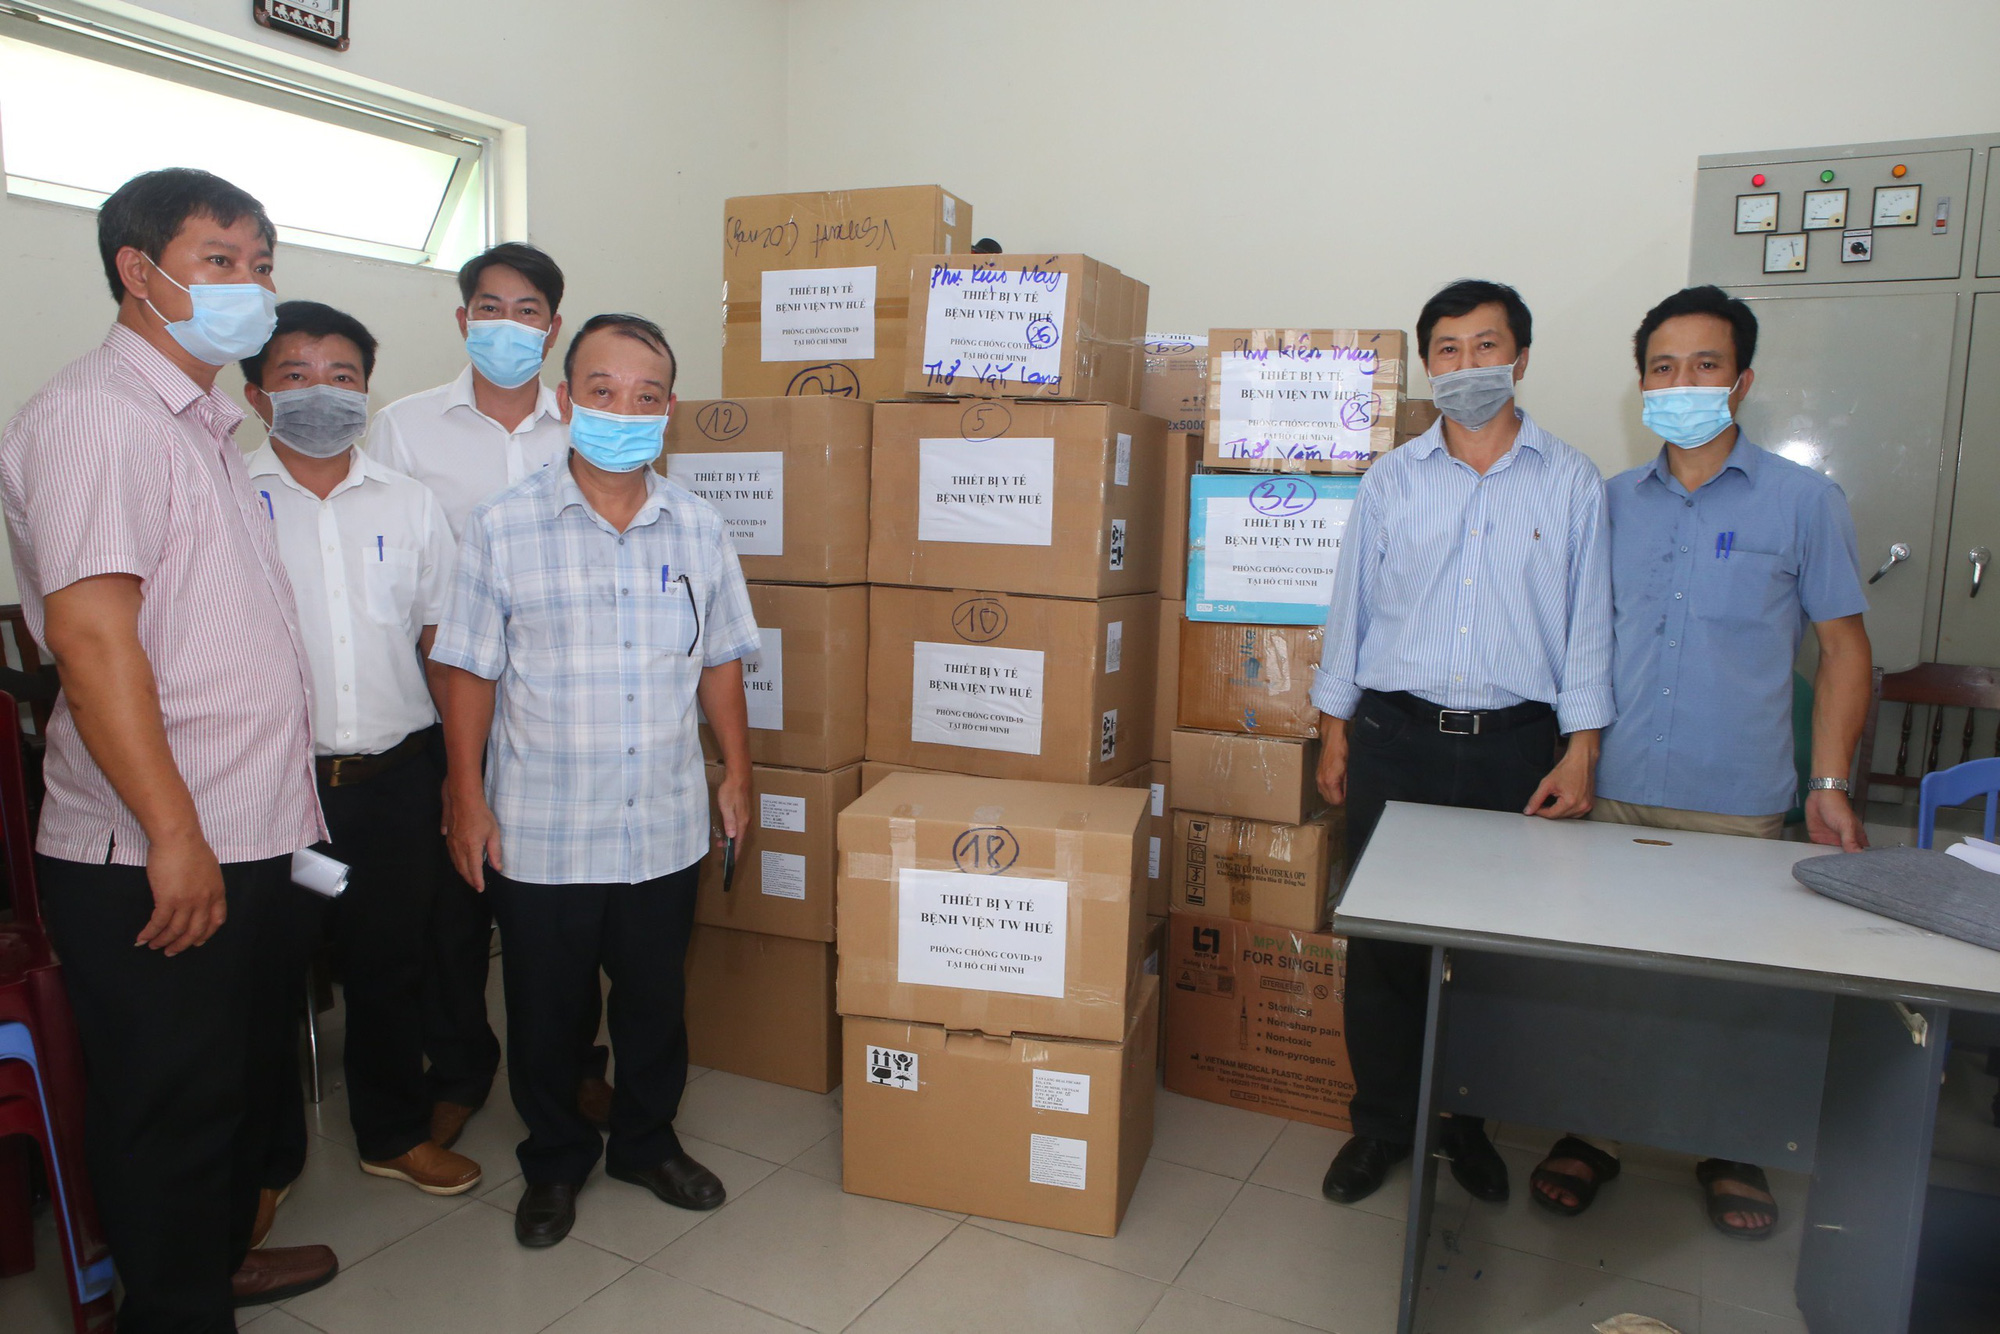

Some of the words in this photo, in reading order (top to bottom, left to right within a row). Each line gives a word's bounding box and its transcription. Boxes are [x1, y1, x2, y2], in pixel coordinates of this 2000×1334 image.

[789, 285, 818, 295] THIẾT
[821, 287, 830, 296] BỊ
[833, 286, 839, 294] Y
[962, 289, 996, 301] THIẾT
[999, 292, 1010, 303] BỊ
[1014, 293, 1022, 302] Y
[1024, 291, 1039, 303] TẾ
[776, 303, 801, 313] BỆNH
[804, 301, 825, 312] VIỆN
[846, 299, 865, 309] HUẾ
[945, 308, 975, 319] BỆNH
[978, 309, 1004, 322] VIỆN
[1008, 311, 1024, 321] TW
[1029, 311, 1052, 323] HUẾ
[782, 327, 804, 335] PHÒNG
[1031, 326, 1050, 343] 26
[817, 337, 828, 345] CHÍ
[951, 337, 976, 347] PHÒNG
[978, 339, 1005, 348] CHỐNG
[963, 352, 976, 360] TẠI
[977, 351, 989, 360] HỒ
[990, 352, 1004, 361] CHÍ
[1006, 354, 1026, 362] MINH
[1259, 369, 1297, 381] THIẾT
[1301, 371, 1312, 383] BỊ
[1317, 372, 1325, 381] Y
[1328, 370, 1344, 382] TẾ
[1241, 389, 1274, 402] BỆNH
[1278, 390, 1308, 402] VIỆN
[1311, 390, 1329, 400] TW
[1347, 400, 1381, 423] 25
[703, 407, 739, 433] 12
[694, 471, 723, 481] THIẾT
[726, 473, 735, 483] BỊ
[739, 473, 745, 481] Y
[748, 470, 760, 481] TẾ
[951, 474, 985, 485] THIẾT
[988, 476, 998, 487] BỊ
[1002, 476, 1009, 485] Y
[1012, 474, 1026, 485] TẾ
[709, 489, 731, 501] VIỆN
[734, 491, 750, 499] TW
[753, 488, 773, 499] HUẾ
[936, 493, 965, 504] BỆNH
[969, 493, 994, 505] VIỆN
[998, 494, 1015, 503] TW
[1019, 493, 1041, 504] HUẾ
[1259, 483, 1303, 510] 32
[1243, 517, 1280, 528] THIẾT
[1284, 519, 1295, 530] BỊ
[1299, 520, 1307, 528] Y
[1311, 518, 1326, 529] TẾ
[1225, 536, 1257, 547] BỆNH
[1262, 536, 1290, 548] VIỆN
[1294, 538, 1314, 547] TW
[1232, 564, 1261, 573] PHÒNG
[1263, 565, 1293, 574] CHỐNG
[1295, 567, 1333, 575] COVID-19
[1247, 577, 1261, 586] TẠI
[1277, 577, 1293, 586] CHÍ
[1295, 579, 1317, 587] MINH
[956, 606, 998, 633] 10
[944, 663, 977, 675] THIẾT
[980, 666, 990, 678] BỊ
[994, 668, 1001, 677] Y
[1004, 667, 1018, 678] TẾ
[753, 680, 773, 691] HUẾ
[929, 679, 957, 691] BỆNH
[961, 683, 986, 695] VIỆN
[989, 686, 1006, 695] TW
[1010, 687, 1032, 698] HUẾ
[936, 708, 960, 717] PHÒNG
[963, 710, 988, 720] CHỐNG
[990, 714, 1023, 723] COVID-19
[948, 722, 960, 730] TẠI
[962, 722, 973, 730] HỒ
[975, 724, 988, 732] CHÍ
[990, 726, 1009, 734] MINH
[959, 834, 1004, 868] 18
[1270, 869, 1293, 879] OTSUKA
[1294, 872, 1306, 880] OPV
[940, 894, 982, 907] THIẾT
[987, 898, 1000, 911] BỊ
[1004, 899, 1013, 910] Y
[1017, 899, 1035, 912] TẾ
[921, 912, 957, 925] BỆNH
[962, 915, 995, 930] VIỆN
[999, 919, 1020, 930] TW
[1025, 921, 1053, 934] HUẾ
[1254, 936, 1285, 952] MPV
[930, 944, 962, 955] PHÒNG
[965, 947, 998, 959] CHỐNG
[1000, 952, 1042, 963] COVID-19
[947, 960, 962, 969] TẠI
[964, 960, 977, 970] HỒ
[980, 962, 997, 972] CHÍ
[999, 965, 1024, 974] MINH
[1243, 950, 1273, 966] FOR
[1278, 956, 1334, 976] SINGLE
[1262, 979, 1290, 990] STERILE
[1267, 1017, 1317, 1033] Non-sharp
[1320, 1027, 1340, 1037] pain
[1266, 1032, 1312, 1047] Non-toxic
[1265, 1046, 1336, 1066] Non-pyrogenic
[1205, 1055, 1236, 1068] VIETNAM
[1238, 1061, 1269, 1075] MEDICAL
[1272, 1068, 1302, 1080] PLASTIC
[1304, 1075, 1326, 1085] JOINT
[1328, 1080, 1354, 1091] STOCK
